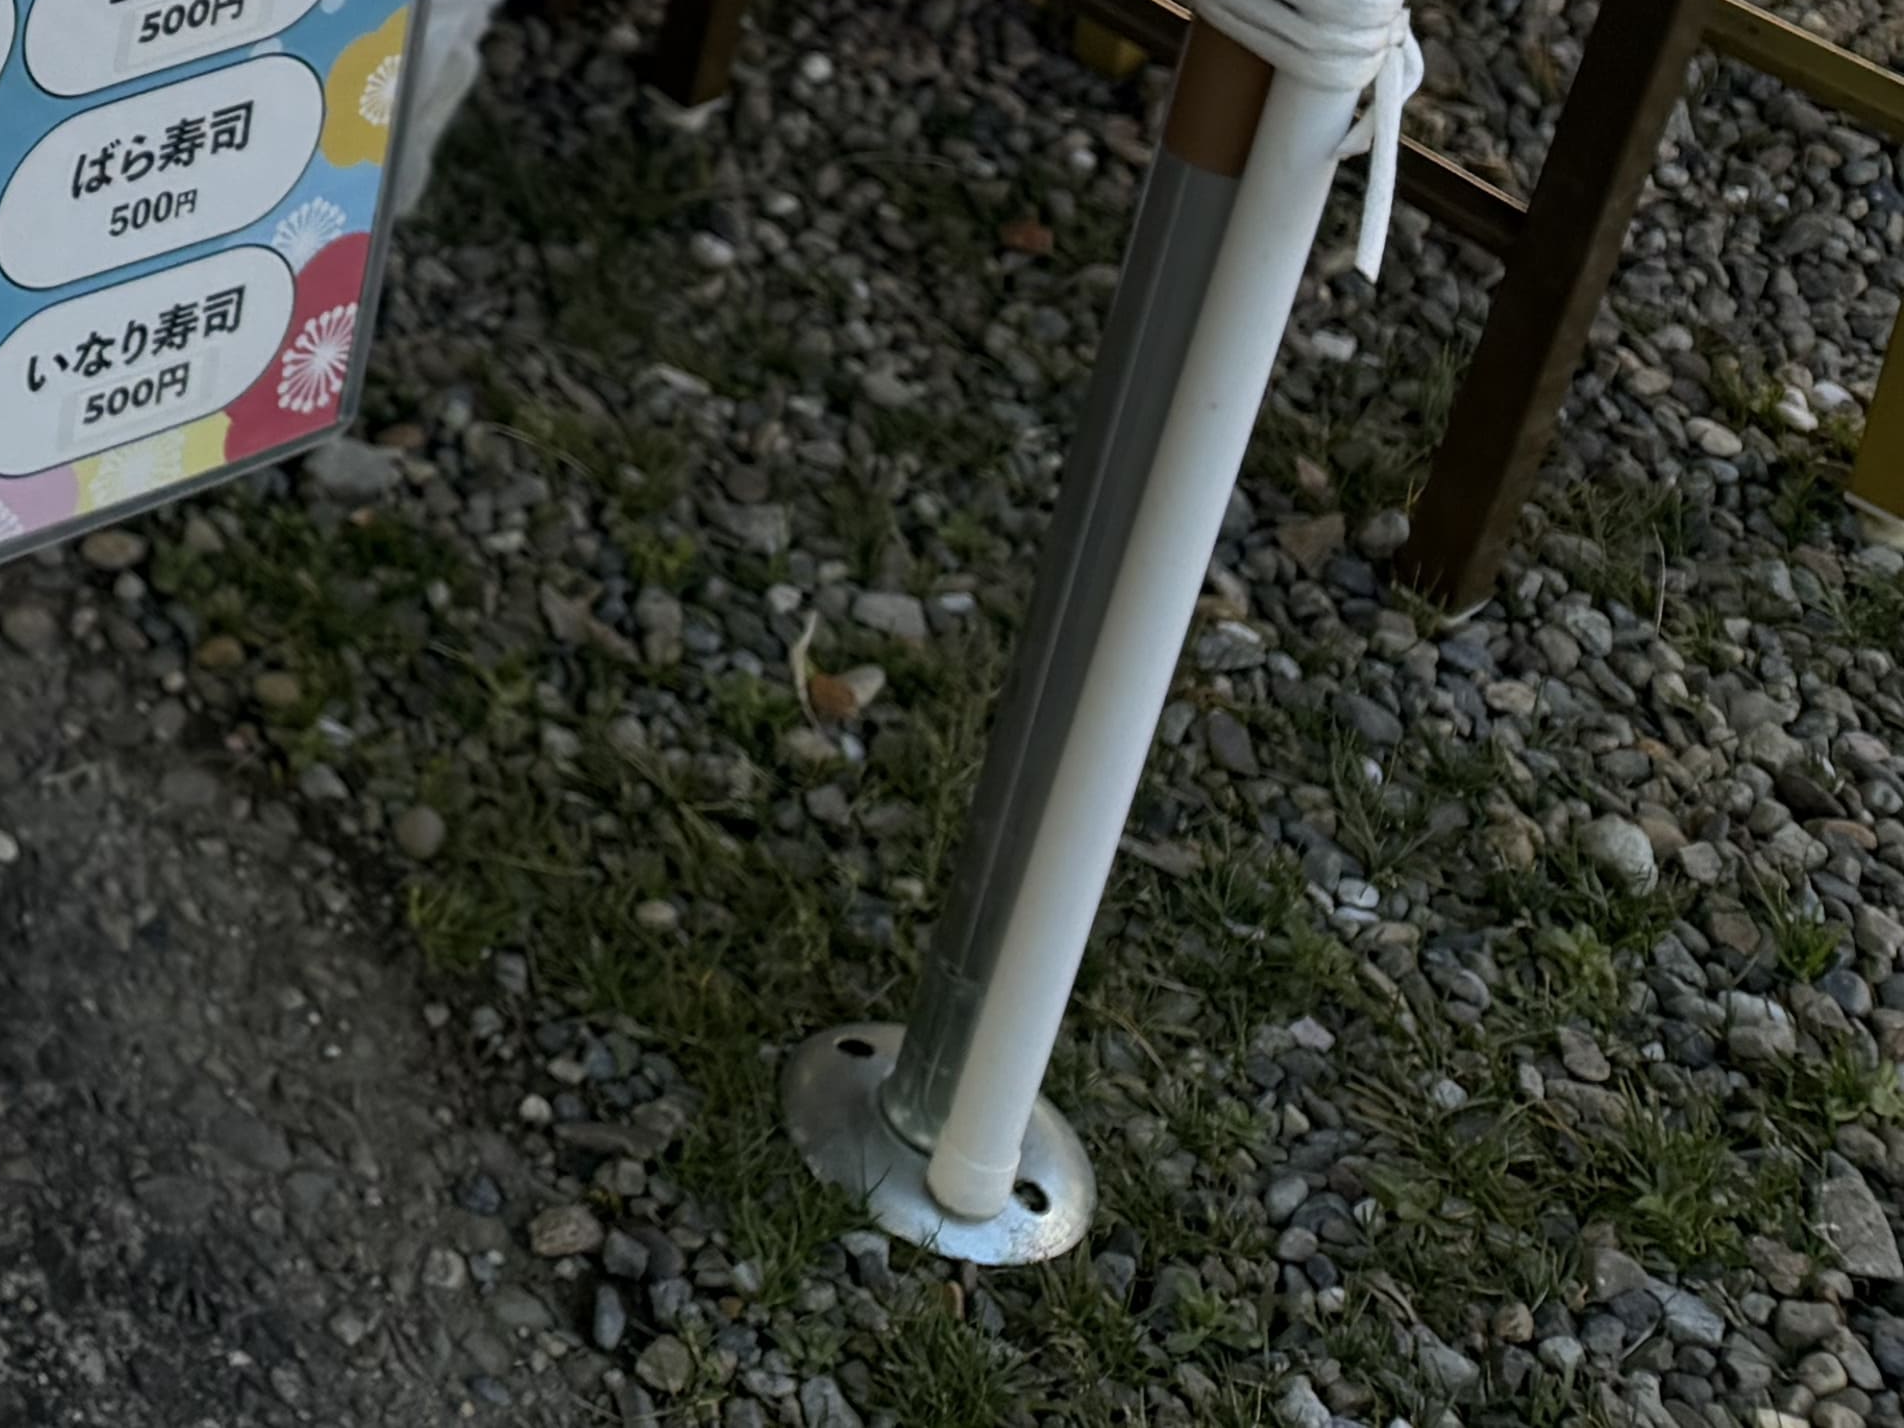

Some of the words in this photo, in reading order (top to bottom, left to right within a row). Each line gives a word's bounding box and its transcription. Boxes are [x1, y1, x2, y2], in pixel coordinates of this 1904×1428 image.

[71, 100, 254, 200] ばら寿司
[108, 188, 198, 237] 500円
[27, 285, 246, 393] いなり寿司
[83, 361, 190, 425] 500円
